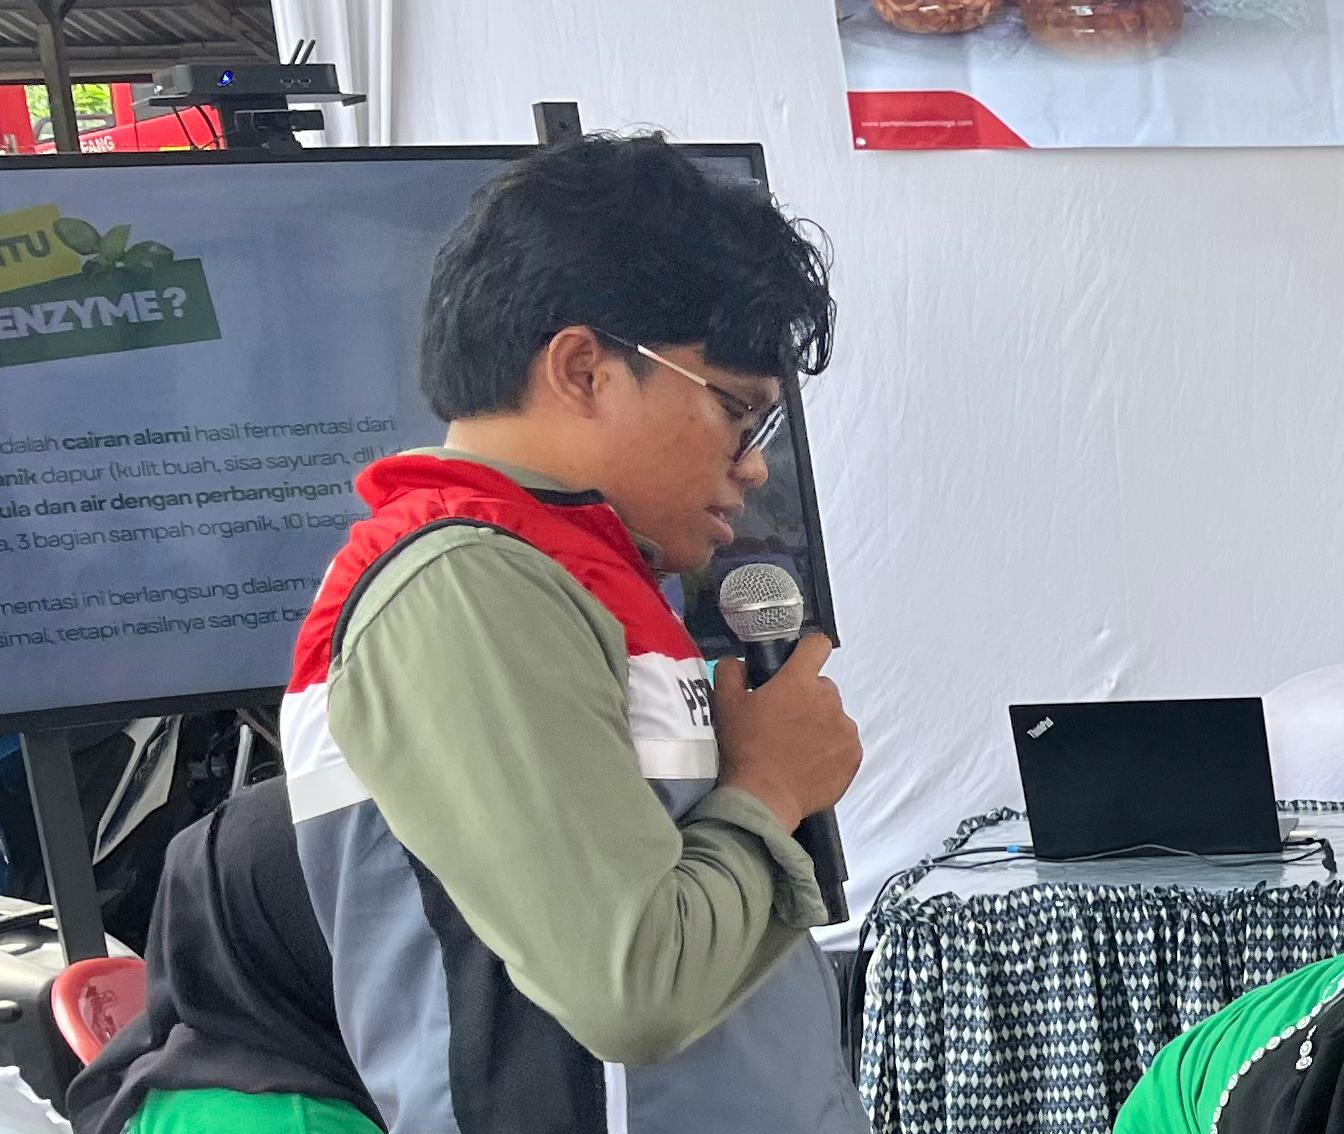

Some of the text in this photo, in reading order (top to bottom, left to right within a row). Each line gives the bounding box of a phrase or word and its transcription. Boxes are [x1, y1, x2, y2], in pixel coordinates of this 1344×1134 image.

[1, 415, 396, 454] dalah cairan alami hasil fermentasi dari
[41, 465, 105, 485] dapur
[109, 460, 160, 482] (kulit
[162, 456, 221, 476] buah,
[224, 454, 262, 472] sisa
[266, 452, 350, 472] sayuran,
[1, 501, 31, 519] ula
[34, 498, 76, 516] dan
[80, 495, 106, 513] air
[110, 492, 192, 511] dengan
[195, 482, 342, 508] perbangingan
[17, 533, 30, 550] 3
[33, 532, 106, 551] bagian
[109, 521, 195, 544] sampah
[199, 515, 280, 539] organik,
[281, 512, 304, 530] 10
[0, 591, 78, 616] mentasi
[82, 589, 105, 608] ini
[108, 582, 238, 607] berlangsung
[241, 577, 305, 595] dalam
[0, 606, 312, 649] simal, tetapi hasilnya sangat be
